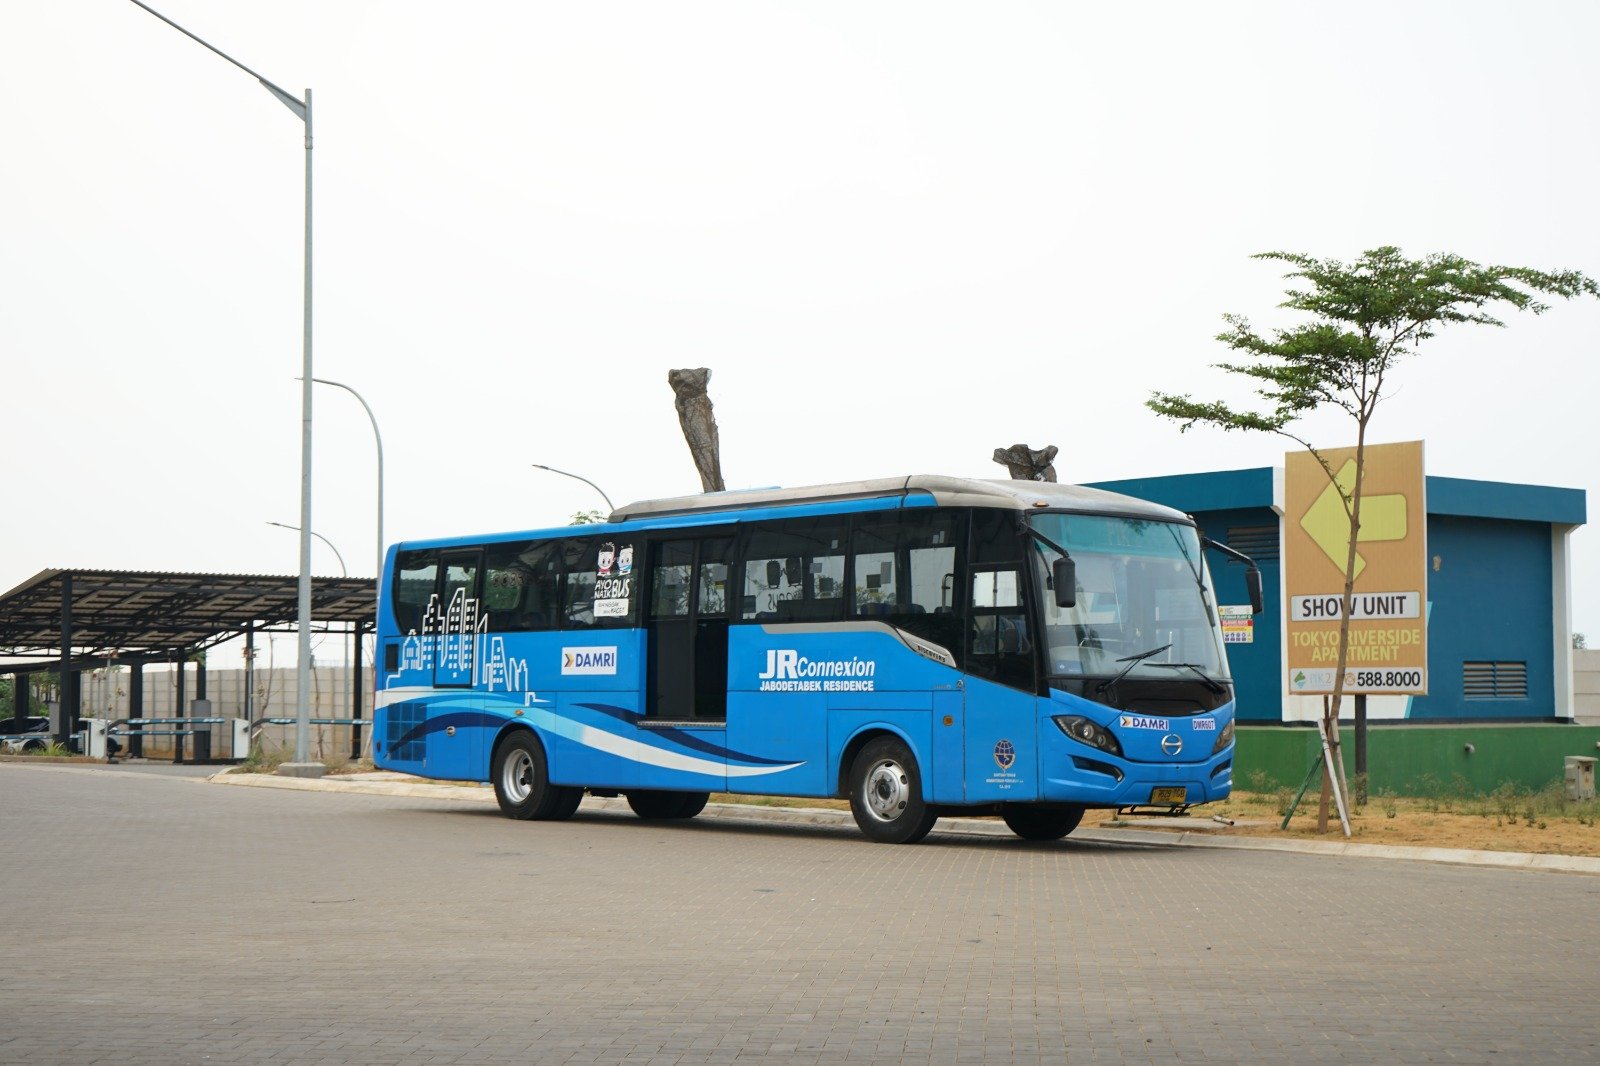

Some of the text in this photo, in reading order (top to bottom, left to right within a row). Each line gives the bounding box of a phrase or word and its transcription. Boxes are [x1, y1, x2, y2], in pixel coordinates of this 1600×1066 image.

[594, 579, 612, 591] AYO
[611, 579, 630, 598] BUS
[594, 590, 612, 599] NAIK
[1363, 595, 1407, 615] UNIT
[1292, 630, 1340, 647] TOKYO
[575, 652, 615, 668] DAMRI
[1311, 646, 1399, 662] APATMENT
[759, 649, 876, 679] JR Connexion
[760, 680, 875, 692] JABODETABEK RESIDENCE
[1357, 671, 1421, 687] 588.8000
[1132, 717, 1168, 730] DAMRI
